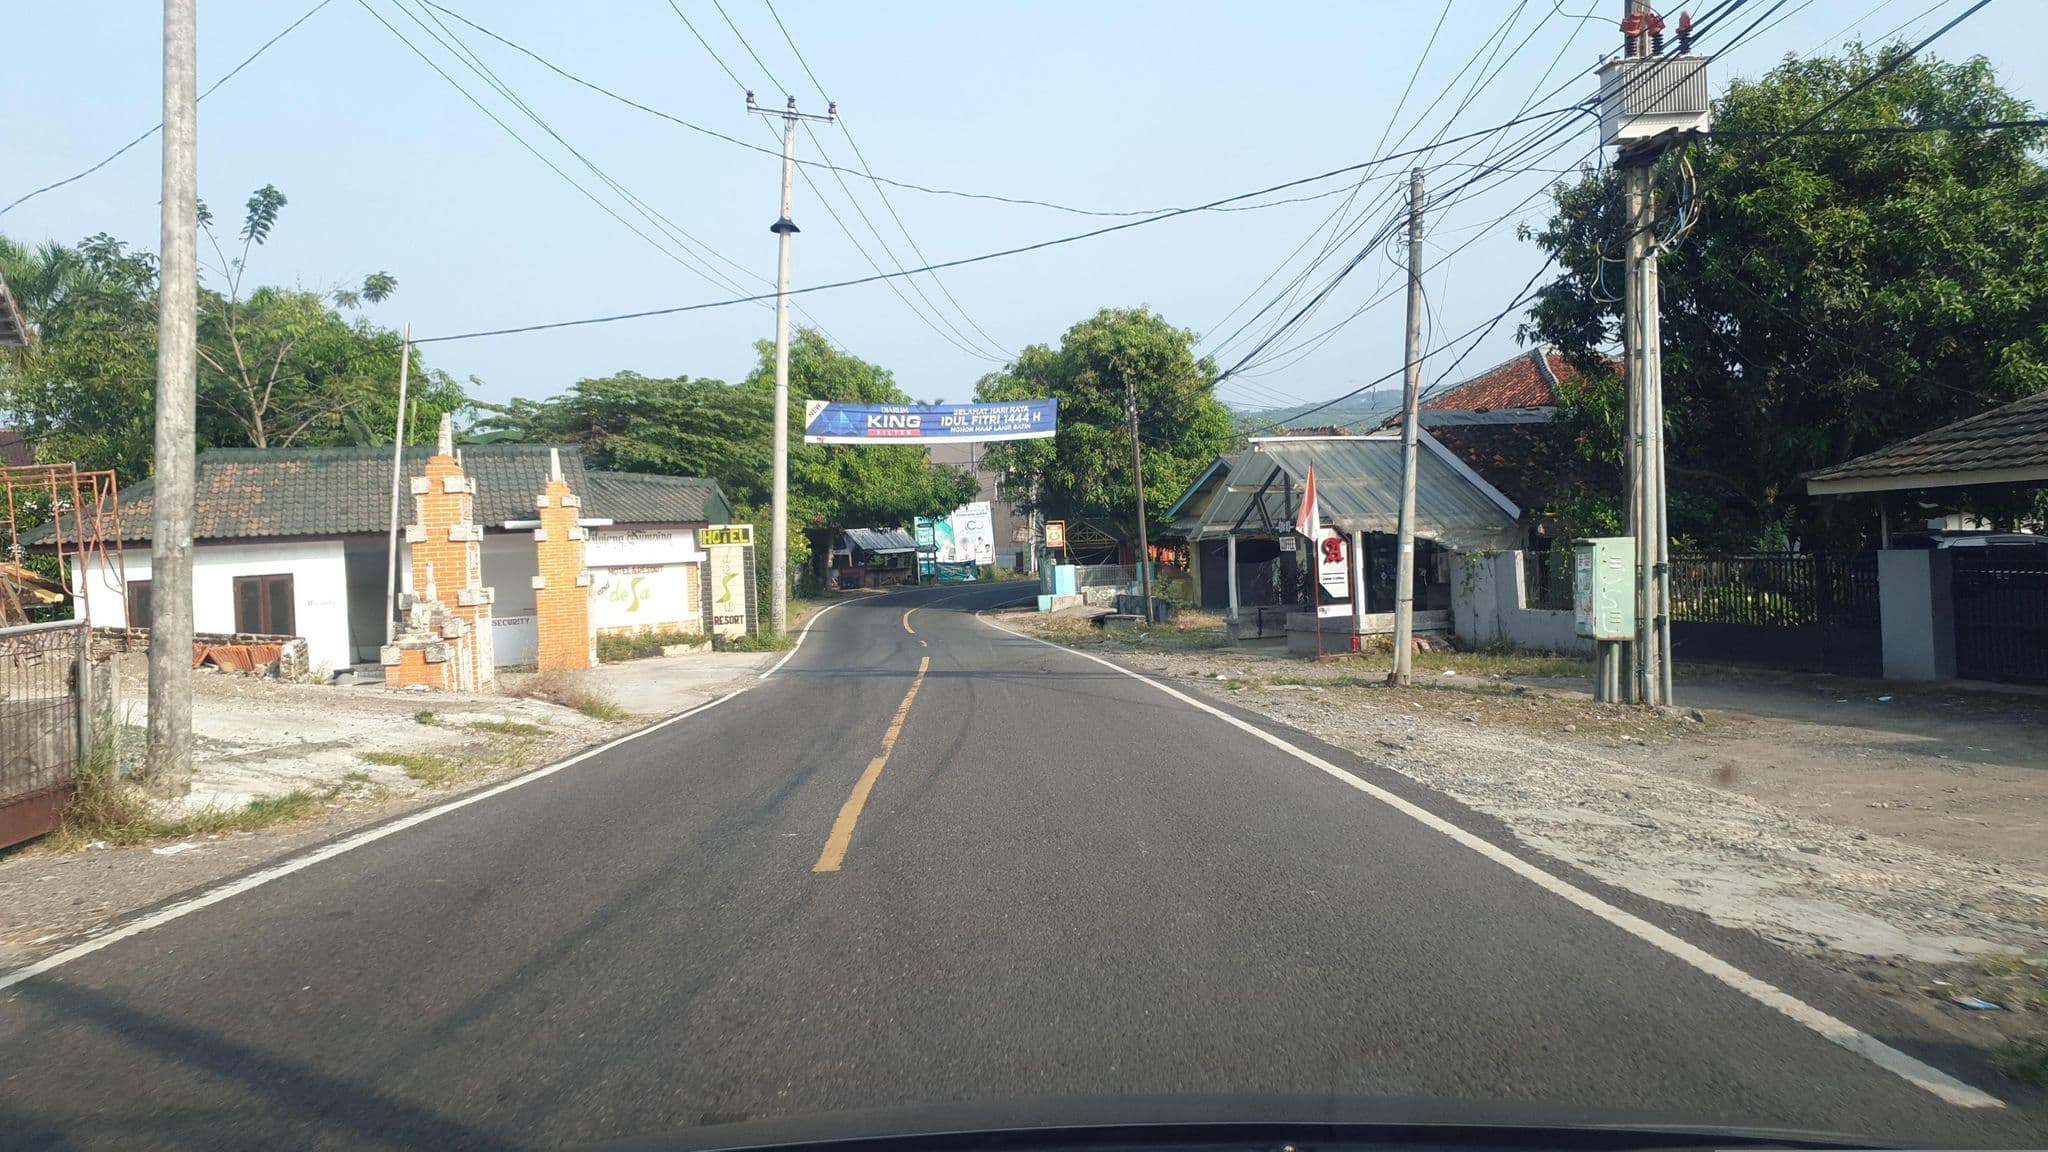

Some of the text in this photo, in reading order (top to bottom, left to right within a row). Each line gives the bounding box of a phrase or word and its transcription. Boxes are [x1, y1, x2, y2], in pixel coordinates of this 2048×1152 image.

[808, 403, 822, 418] NEW
[954, 407, 988, 416] SELAMAT
[990, 406, 1009, 415] HARI
[867, 414, 921, 429] KING
[941, 411, 1041, 427] IDUL FITRI 1444 H
[1013, 423, 1032, 431] BATIN
[703, 529, 748, 544] HOTEL
[491, 617, 530, 627] SECURITY
[714, 615, 744, 625] RESORT
